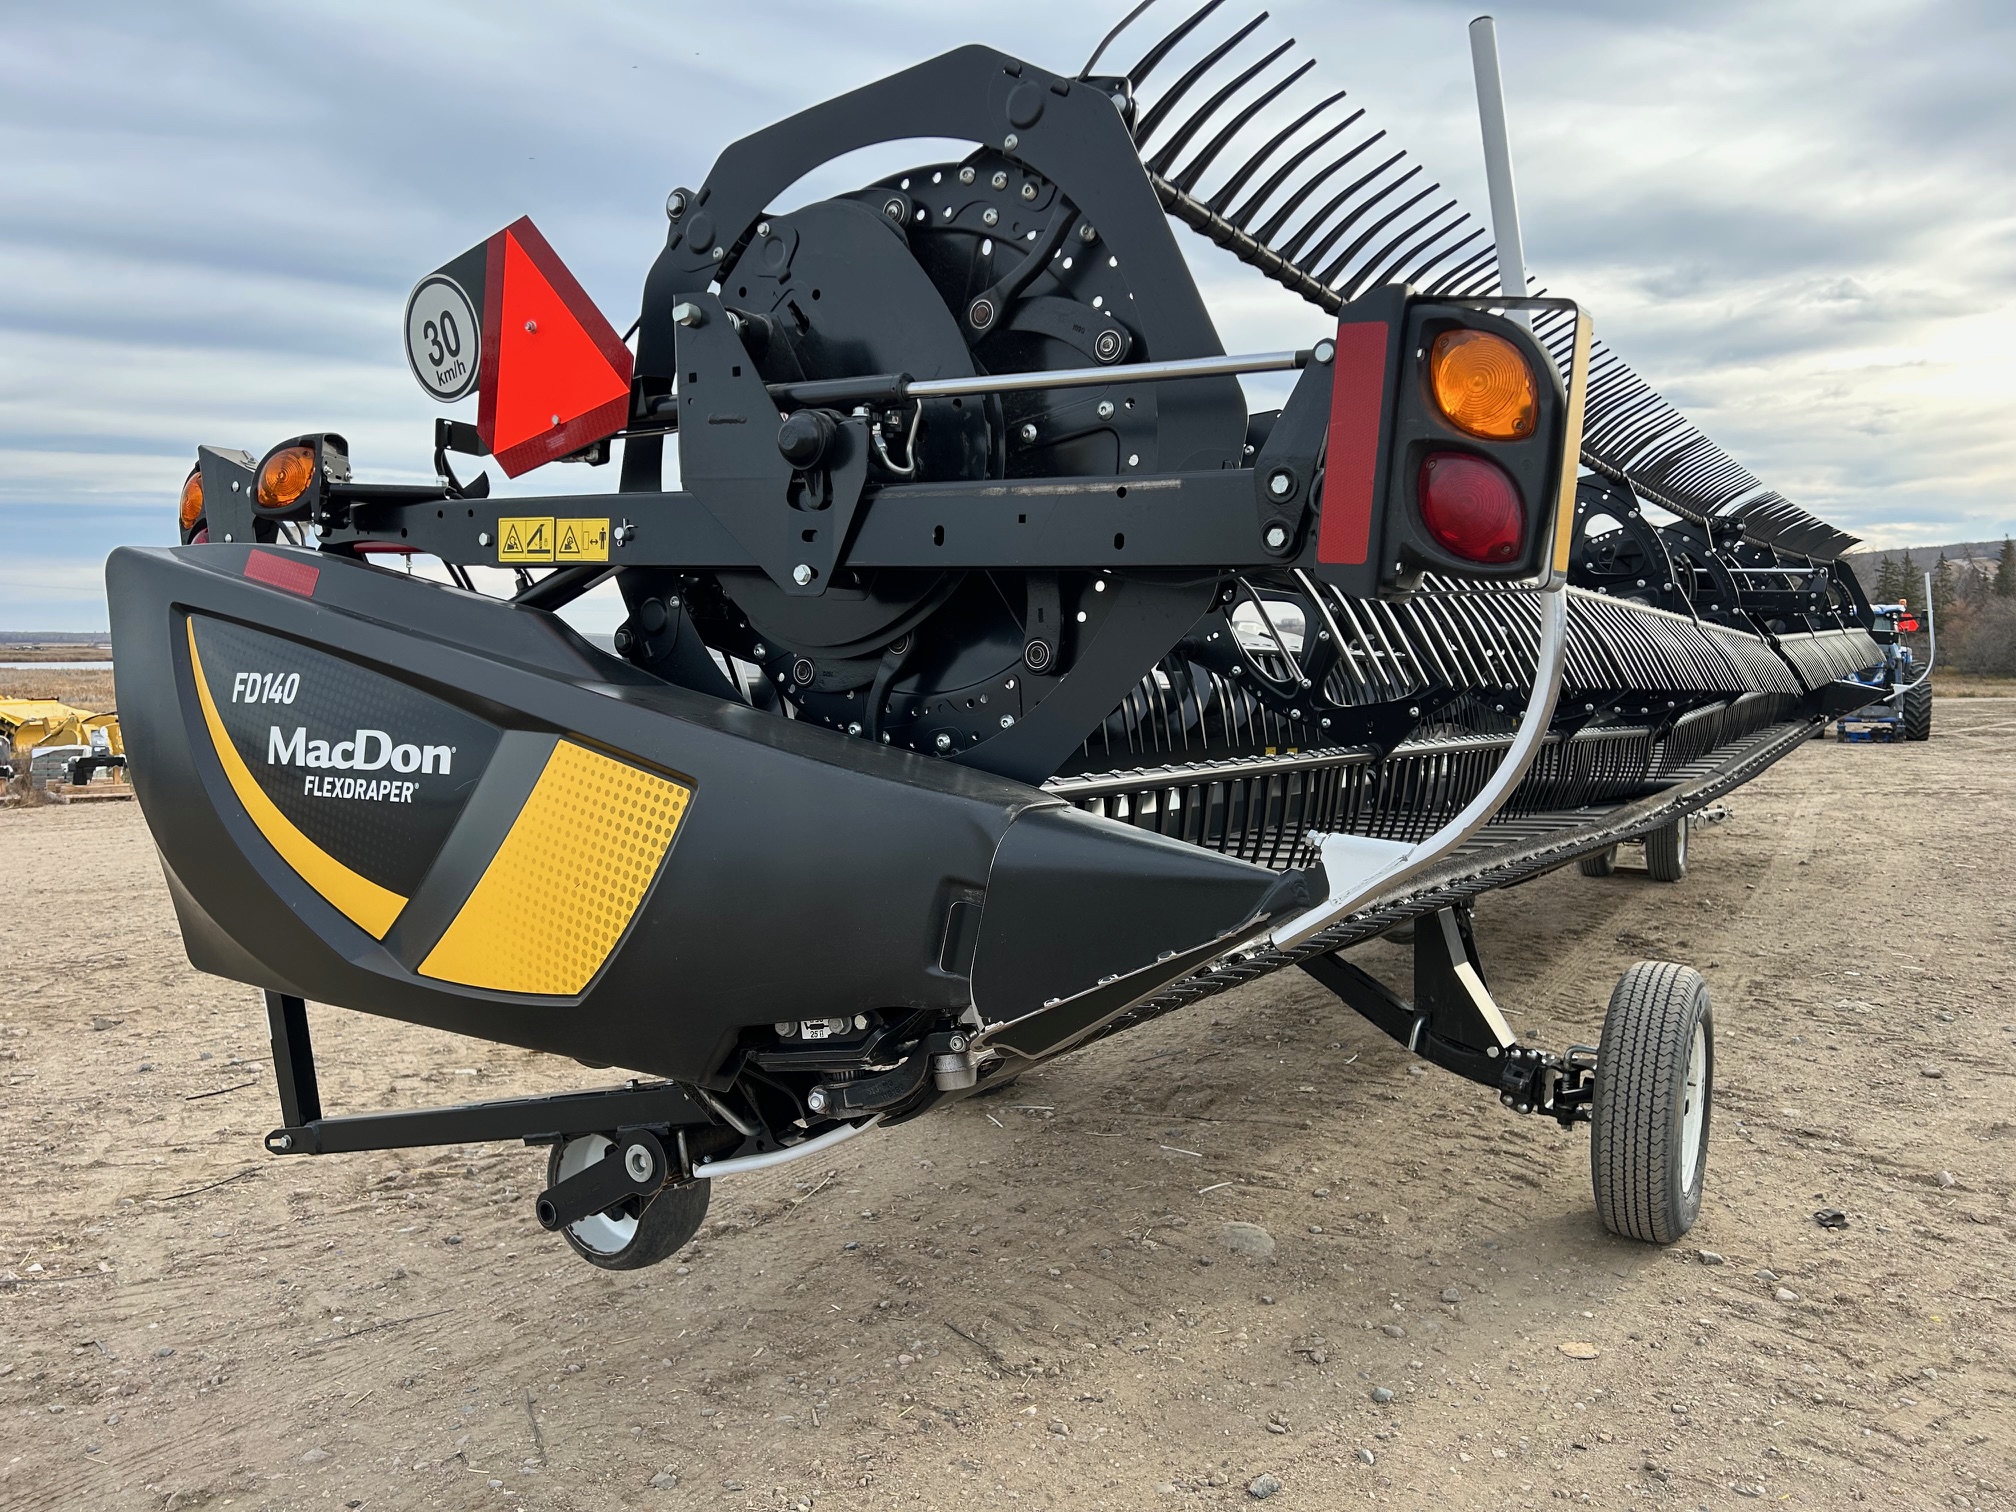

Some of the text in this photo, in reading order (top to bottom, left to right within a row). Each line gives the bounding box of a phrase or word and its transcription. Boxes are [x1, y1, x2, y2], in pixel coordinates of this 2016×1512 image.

[423, 310, 461, 368] 30
[435, 359, 467, 387] km/h
[232, 672, 301, 705] FD140
